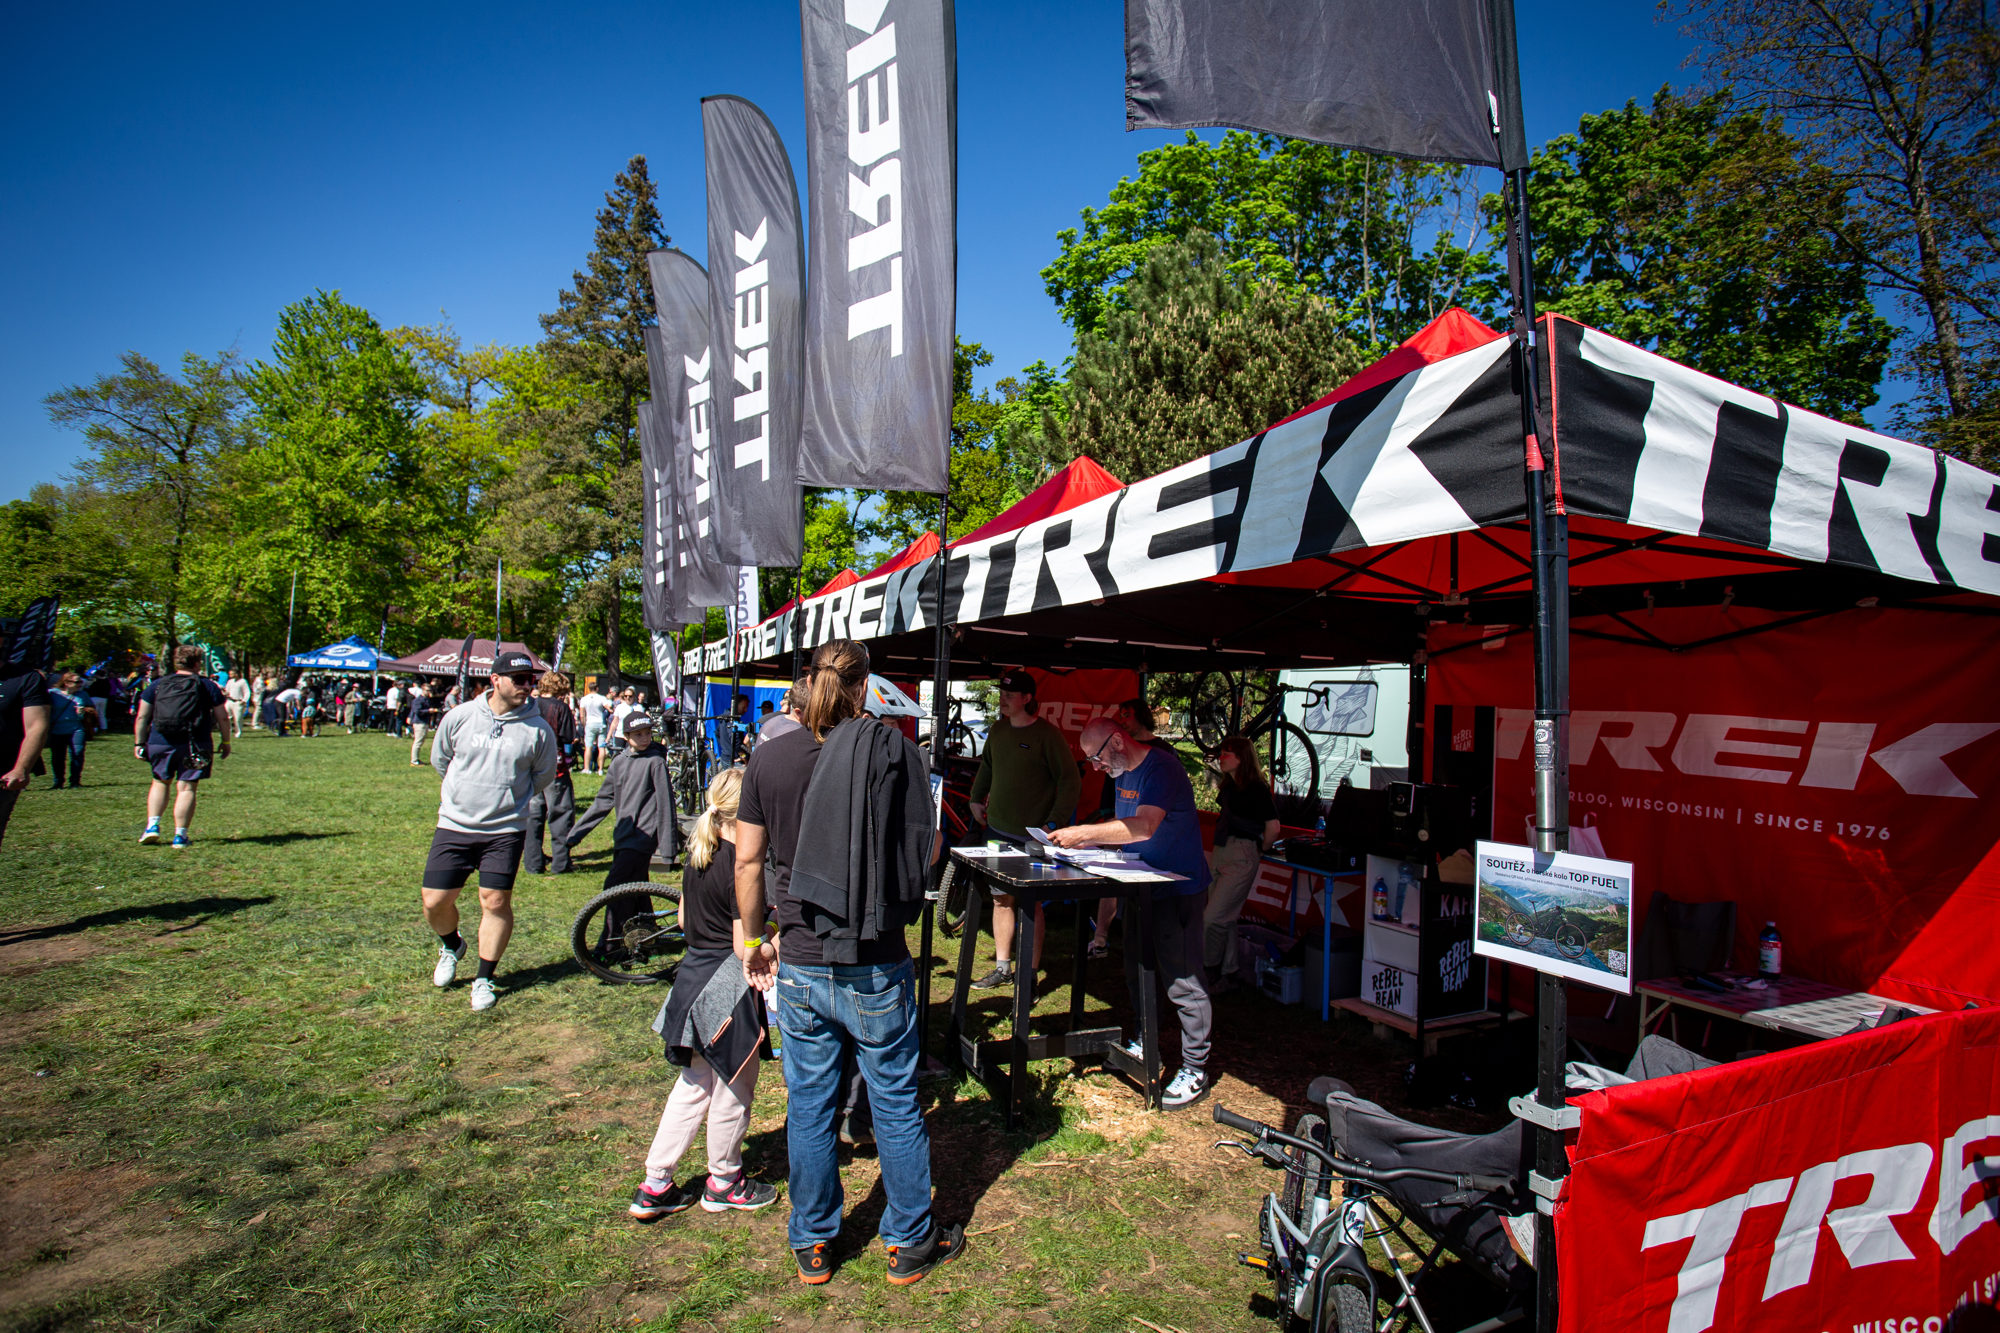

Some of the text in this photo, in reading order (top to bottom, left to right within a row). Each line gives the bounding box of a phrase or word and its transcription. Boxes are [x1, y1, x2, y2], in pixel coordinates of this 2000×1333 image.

[950, 334, 1517, 624] TREK
[800, 555, 935, 649] TREK
[738, 606, 798, 663] TREK
[418, 663, 458, 675] CHALLENGE
[1621, 796, 1726, 820] WISCONSIN
[1754, 812, 1823, 833] SINCE
[1836, 822, 1891, 841] 1976
[1486, 858, 1525, 872] SOUTĚŽ
[1553, 871, 1567, 880] kolo
[1568, 871, 1589, 884] TOP
[1591, 875, 1619, 889] FUEL
[1439, 939, 1473, 977] REBEL
[1371, 967, 1404, 991] REBEL
[1442, 960, 1469, 993] BEAN
[1375, 989, 1402, 1010] BEAN
